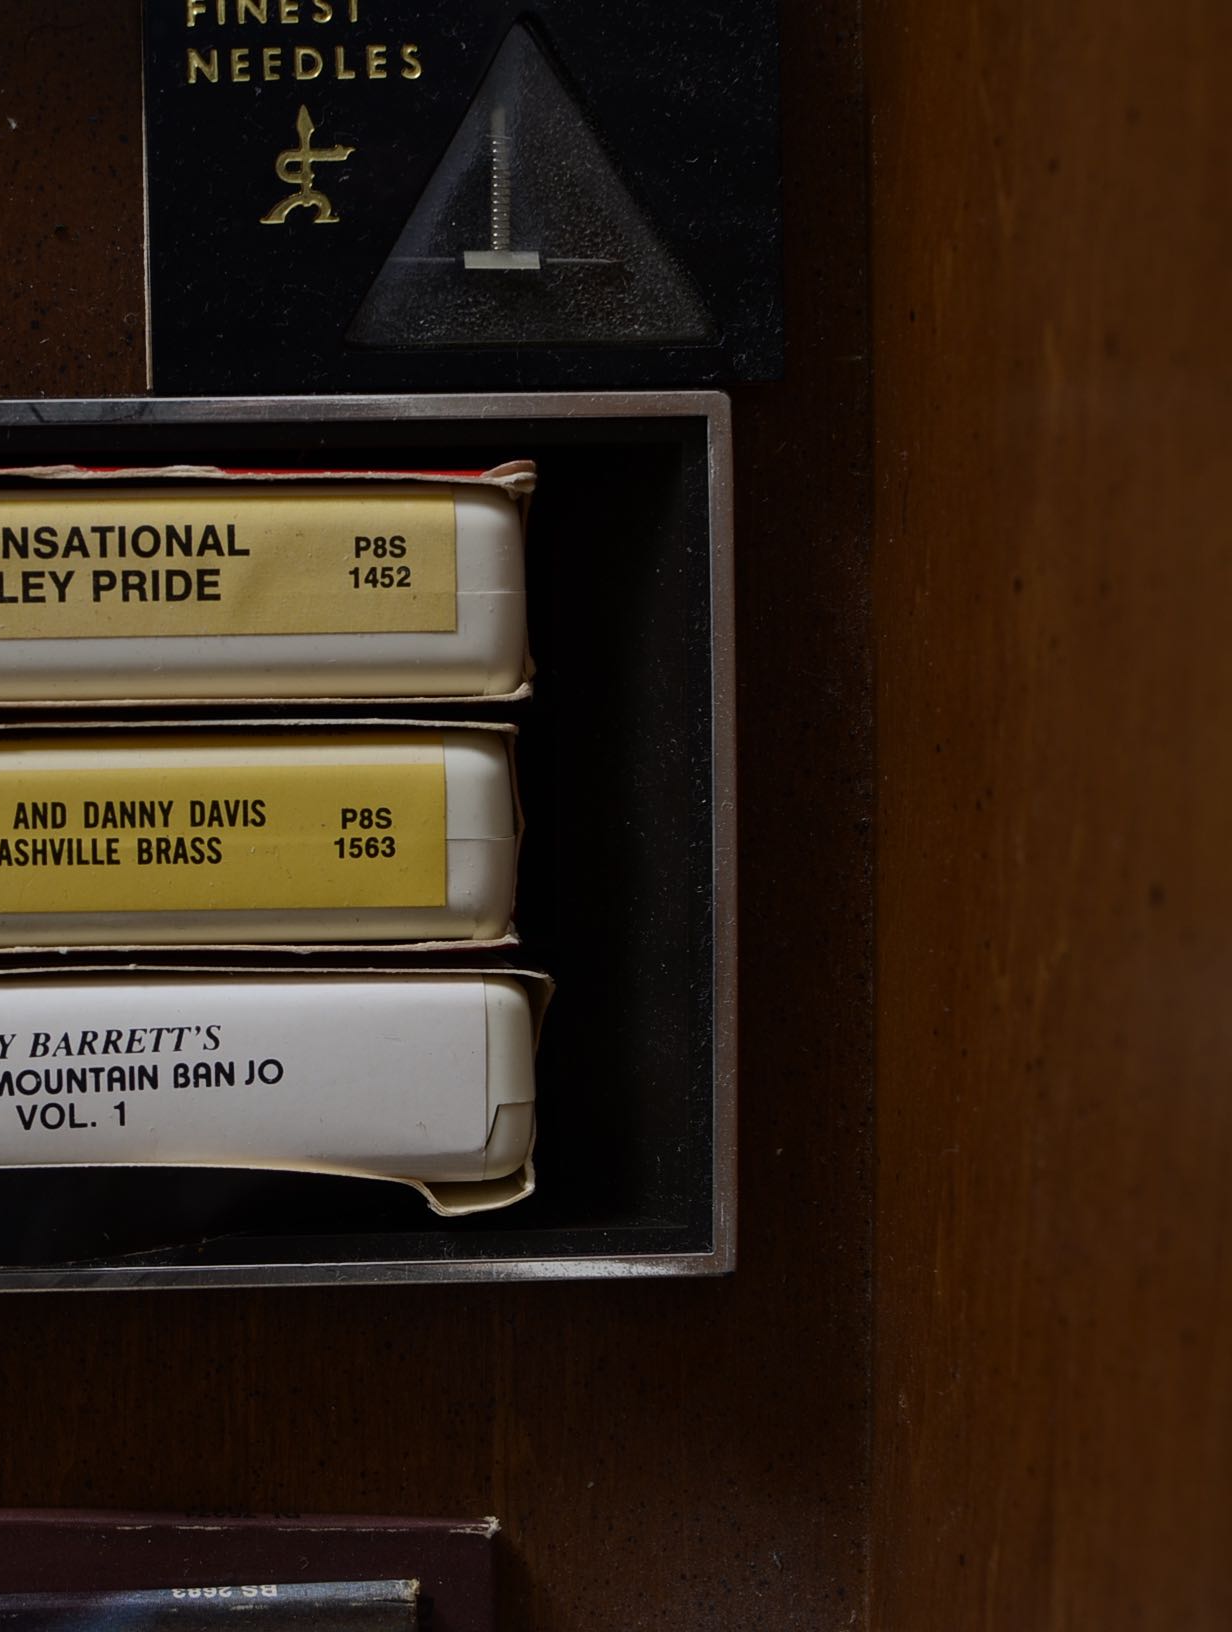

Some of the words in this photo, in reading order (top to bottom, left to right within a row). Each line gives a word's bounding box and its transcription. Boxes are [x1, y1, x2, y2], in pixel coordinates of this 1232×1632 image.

[189, 46, 421, 83] NEEDLES
[355, 536, 406, 558] P8S
[93, 569, 221, 602] PRIDE
[349, 566, 411, 588] 1452
[13, 802, 66, 829] AND
[84, 801, 173, 829] DANNY
[190, 800, 265, 827] DAVIS
[342, 808, 392, 829] P8S
[138, 837, 222, 865] BRASS
[334, 837, 395, 858] 1563
[29, 1025, 220, 1057] BARRETT'S
[16, 1103, 96, 1130] VOL.
[114, 1101, 125, 1126] 1
[241, 1584, 278, 1598] BS
